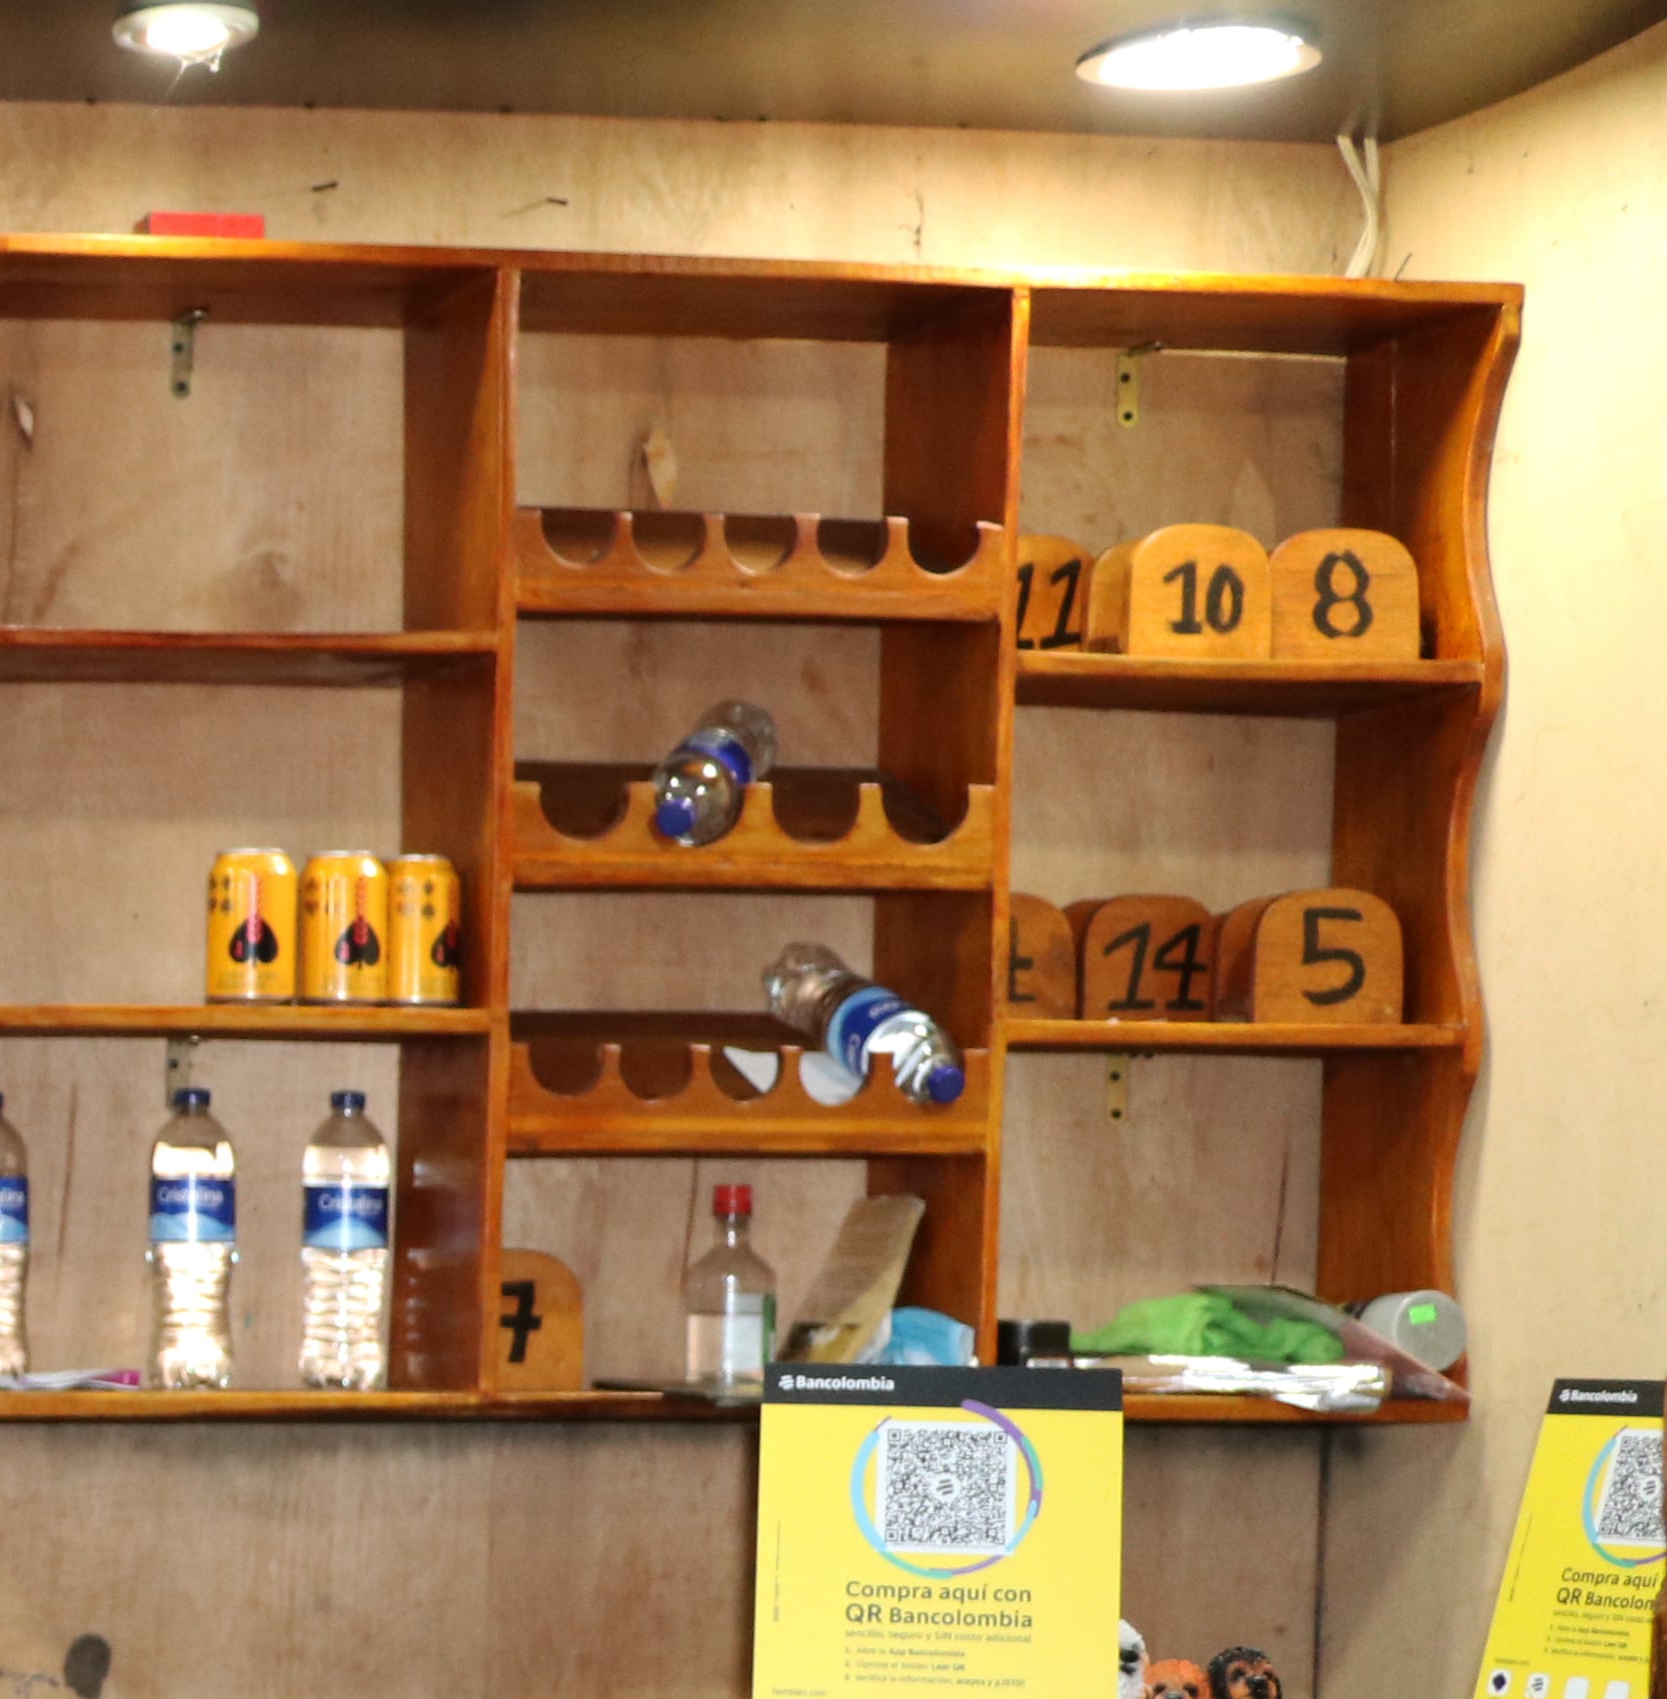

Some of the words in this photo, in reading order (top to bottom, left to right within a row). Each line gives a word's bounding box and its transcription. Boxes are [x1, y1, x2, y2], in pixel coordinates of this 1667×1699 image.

[1163, 561, 1245, 634] 10
[1312, 549, 1373, 638] 8
[1103, 923, 1207, 1011] 14
[1302, 907, 1366, 1004] 5
[500, 1280, 543, 1364] 7
[796, 1374, 895, 1391] Bancolombia
[845, 1580, 932, 1602] Compra
[939, 1583, 988, 1604] aquí
[993, 1588, 1032, 1602] con
[1556, 1587, 1583, 1605] QR
[1561, 1567, 1620, 1586] Compra
[1623, 1573, 1660, 1590] aquí
[845, 1603, 882, 1624] QR
[889, 1606, 1033, 1628] Bancolombia
